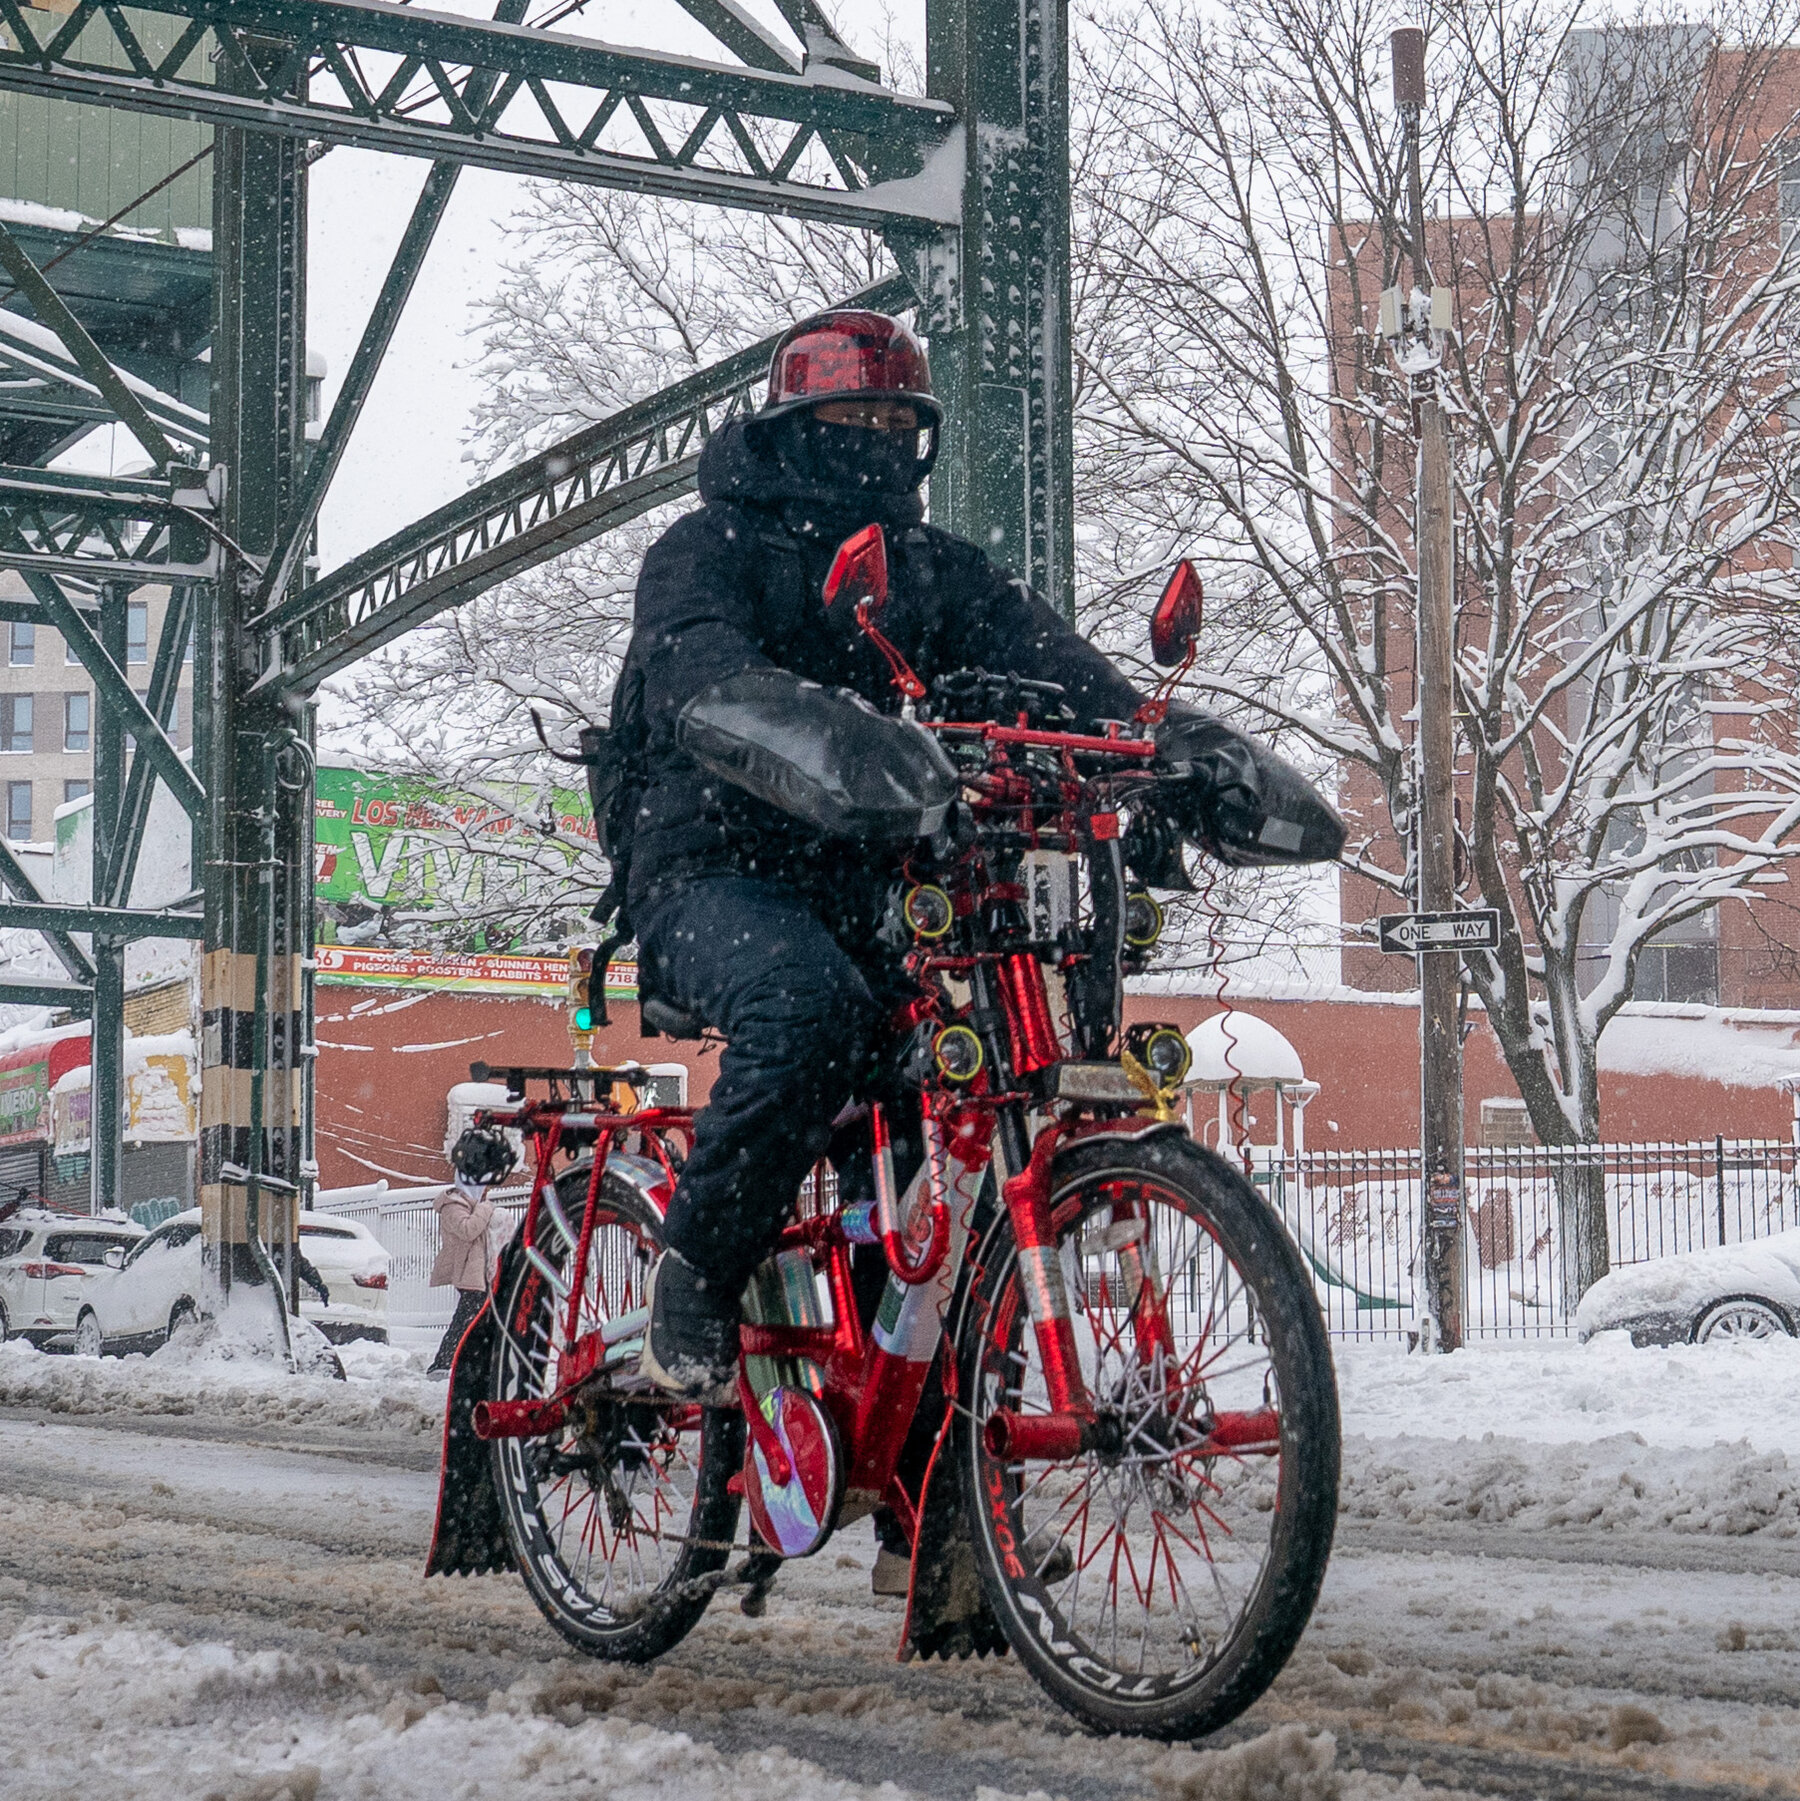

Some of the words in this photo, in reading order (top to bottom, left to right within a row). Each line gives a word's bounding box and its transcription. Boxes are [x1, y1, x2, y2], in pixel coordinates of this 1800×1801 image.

[351, 798, 399, 826] LOS
[1399, 926, 1431, 941] ONE
[1453, 922, 1485, 938] WAY
[353, 961, 408, 973] PIGEONS
[491, 971, 541, 981] RABBITS
[544, 963, 570, 972] HEN
